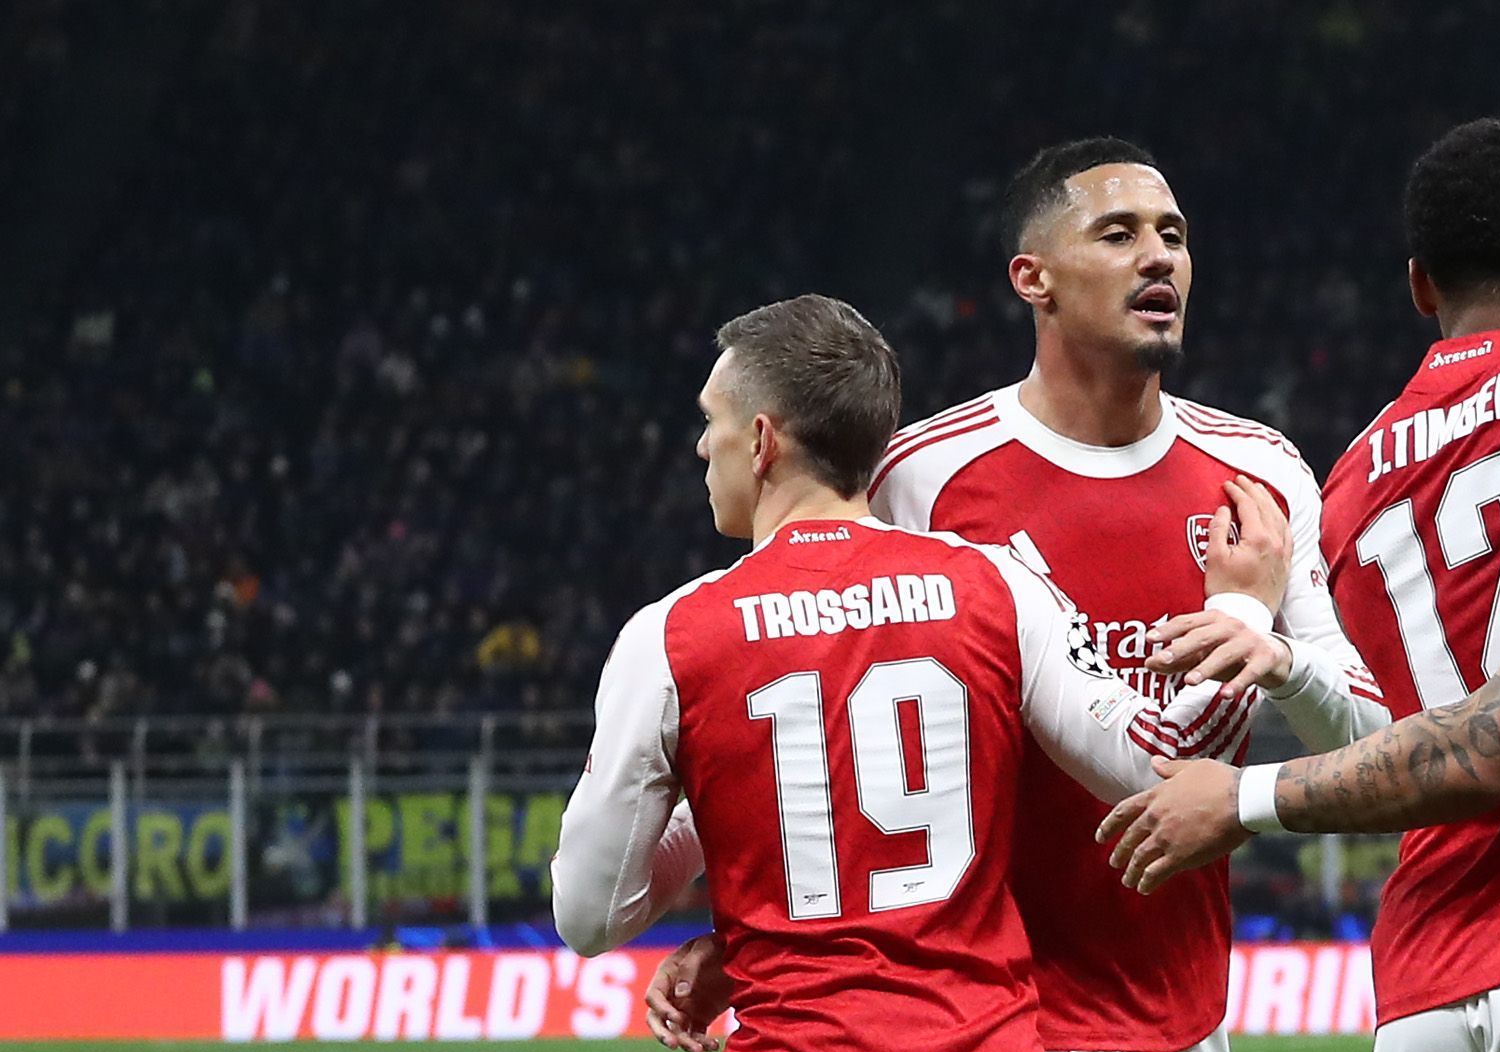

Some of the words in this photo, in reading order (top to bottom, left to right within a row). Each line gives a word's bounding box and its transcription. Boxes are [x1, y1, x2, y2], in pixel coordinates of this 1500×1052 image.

[1429, 340, 1493, 369] Arsenal
[788, 526, 852, 545] Arsenal
[733, 574, 957, 641] TROSSARD
[746, 656, 976, 921] 19
[221, 954, 638, 1041] WORLD'S
